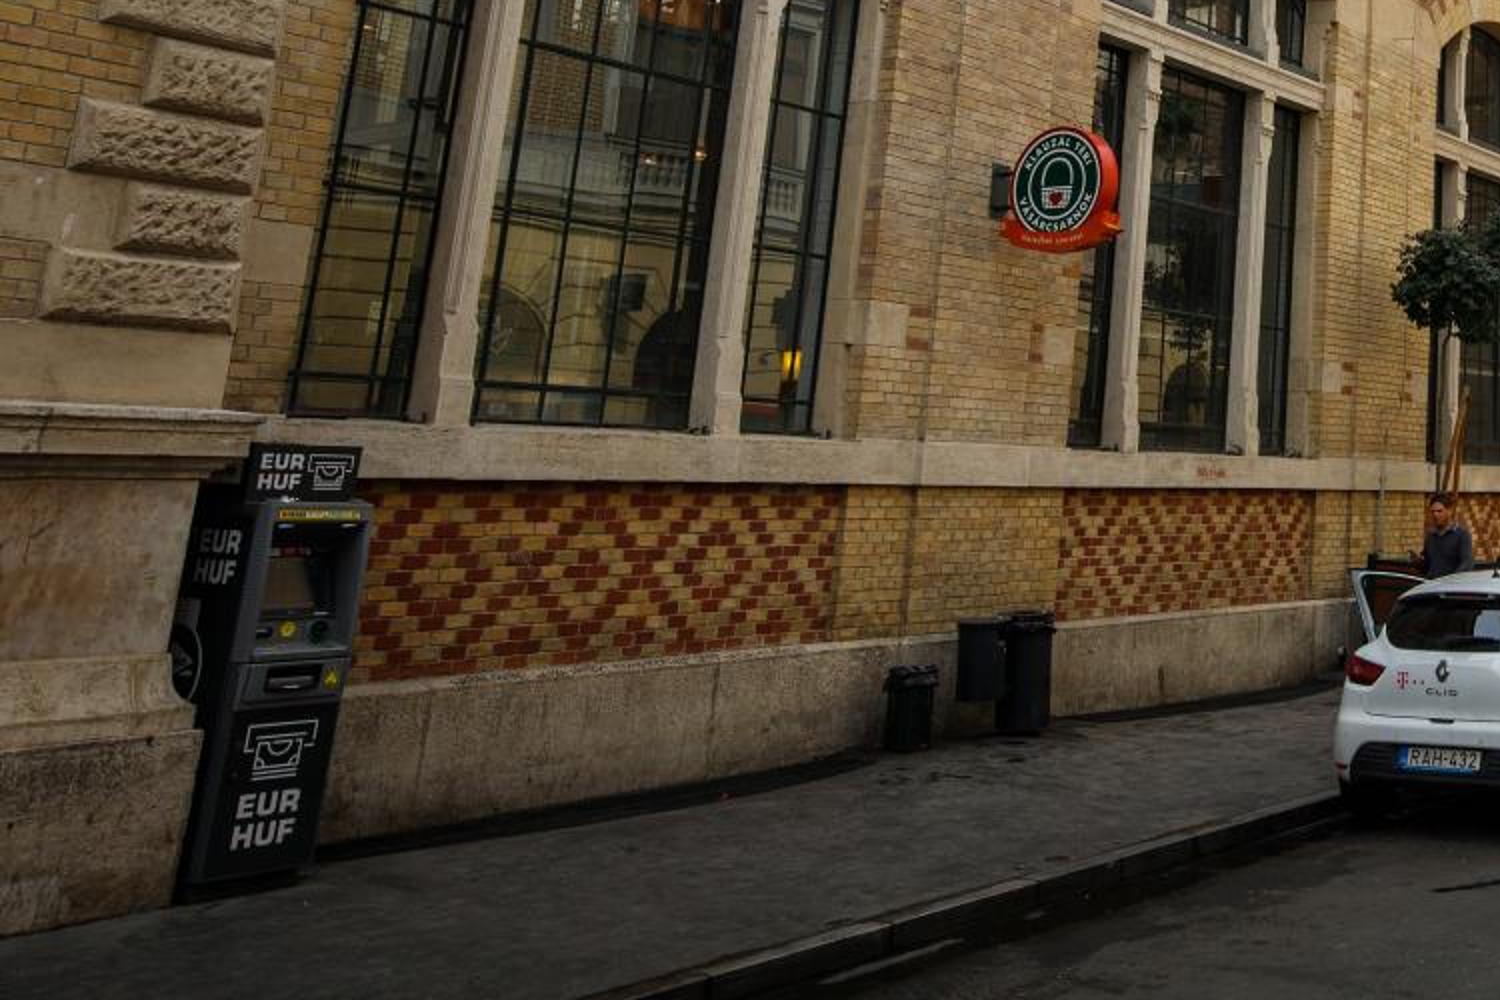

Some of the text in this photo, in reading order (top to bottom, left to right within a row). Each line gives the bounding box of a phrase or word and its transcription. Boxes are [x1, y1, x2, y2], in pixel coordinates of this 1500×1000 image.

[260, 453, 306, 471] EUR
[256, 473, 301, 491] HUF
[202, 529, 241, 554] EUR
[193, 556, 237, 585] HUF
[1410, 749, 1477, 769] RAH-432
[236, 789, 300, 820] EUR
[229, 817, 297, 852] HUF
